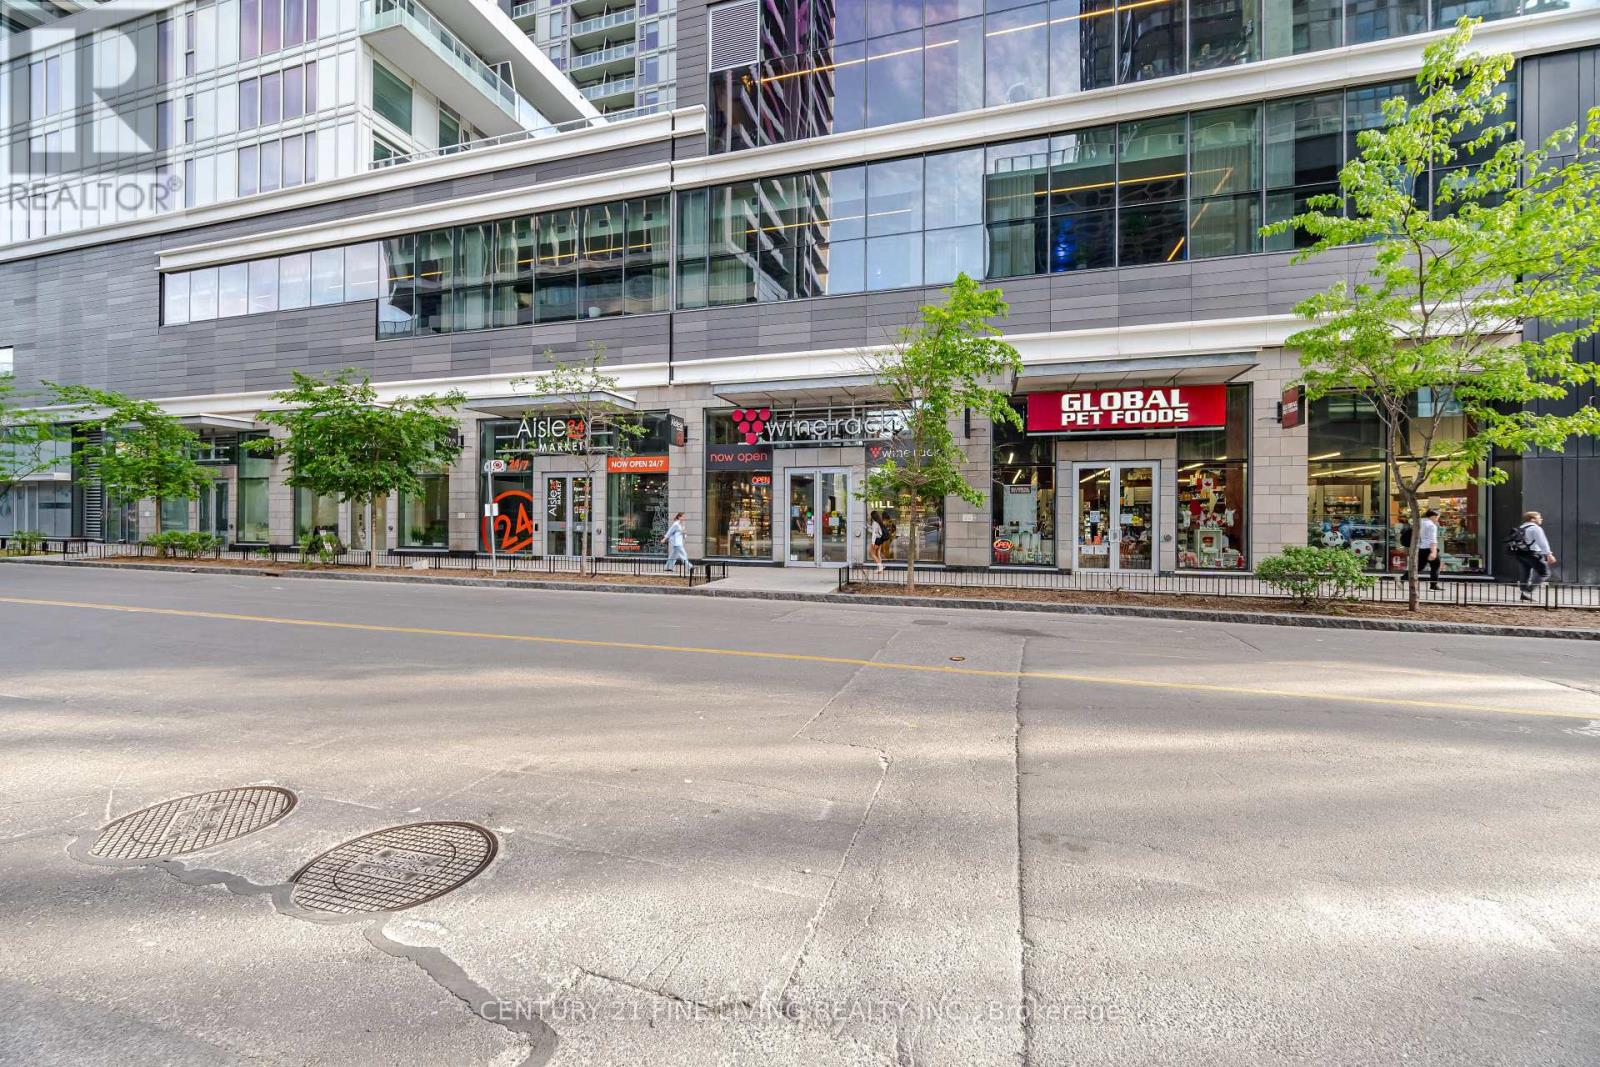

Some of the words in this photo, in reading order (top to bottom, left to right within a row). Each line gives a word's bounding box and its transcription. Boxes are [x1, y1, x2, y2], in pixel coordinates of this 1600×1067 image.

[1061, 389, 1189, 411] GLOBAL
[1061, 411, 1104, 426] PET
[1111, 408, 1189, 424] FOODS
[539, 442, 584, 453] MARKET
[710, 453, 734, 462] now
[737, 452, 768, 463] open
[629, 460, 648, 468] OPEN
[751, 476, 770, 484] OPEN
[494, 502, 533, 549] 24
